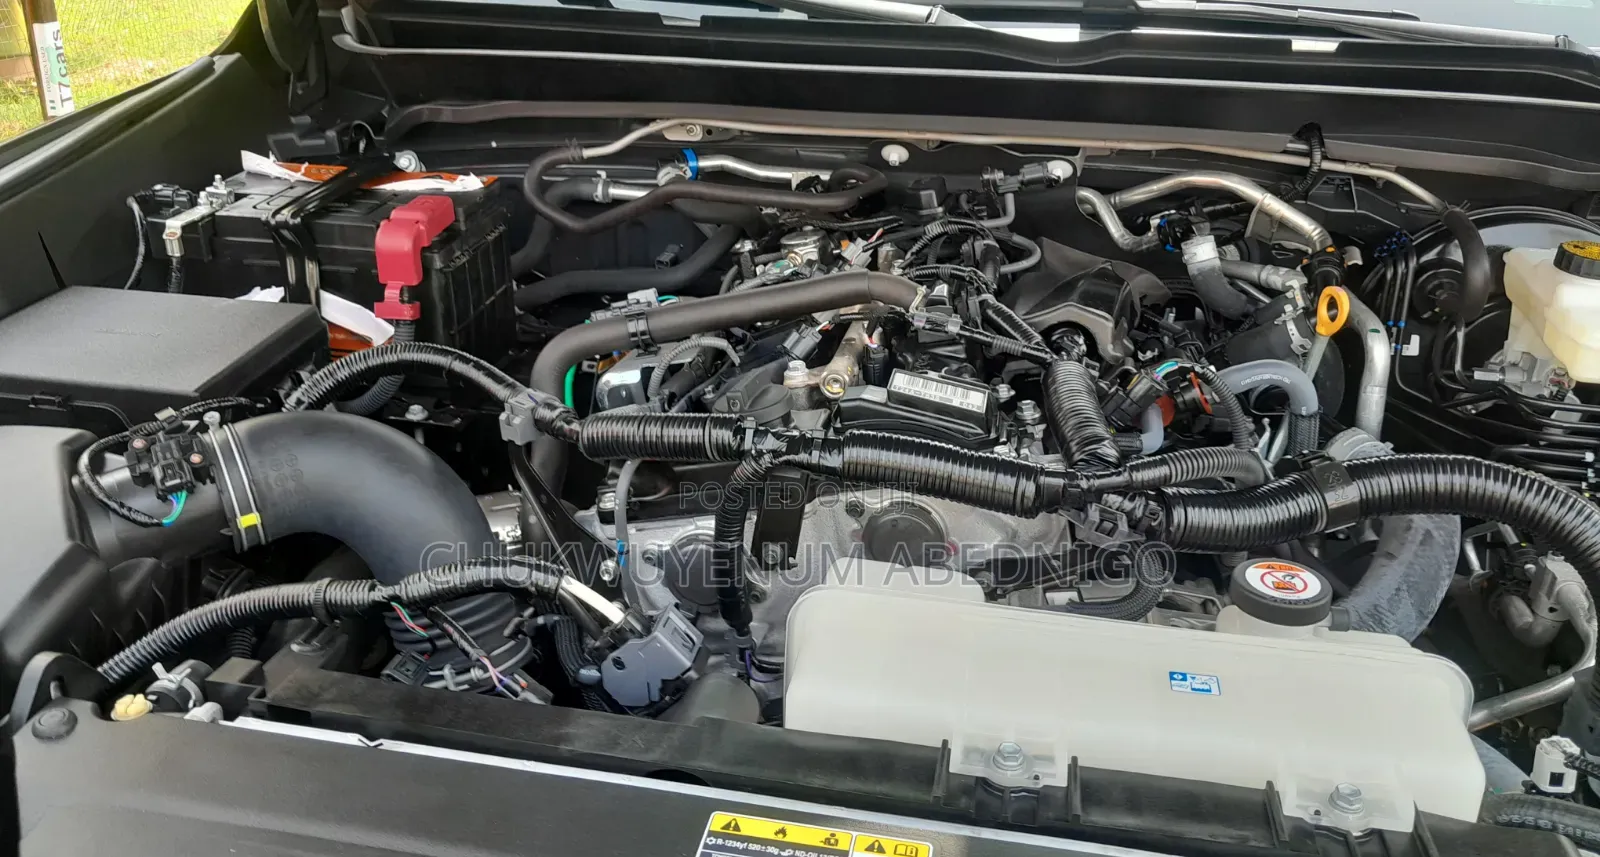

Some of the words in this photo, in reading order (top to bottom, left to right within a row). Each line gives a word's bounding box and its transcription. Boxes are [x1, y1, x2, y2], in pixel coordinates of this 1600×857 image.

[40, 46, 48, 63] USED
[43, 64, 52, 93] FOREIGN
[716, 838, 748, 850] R-1234yf
